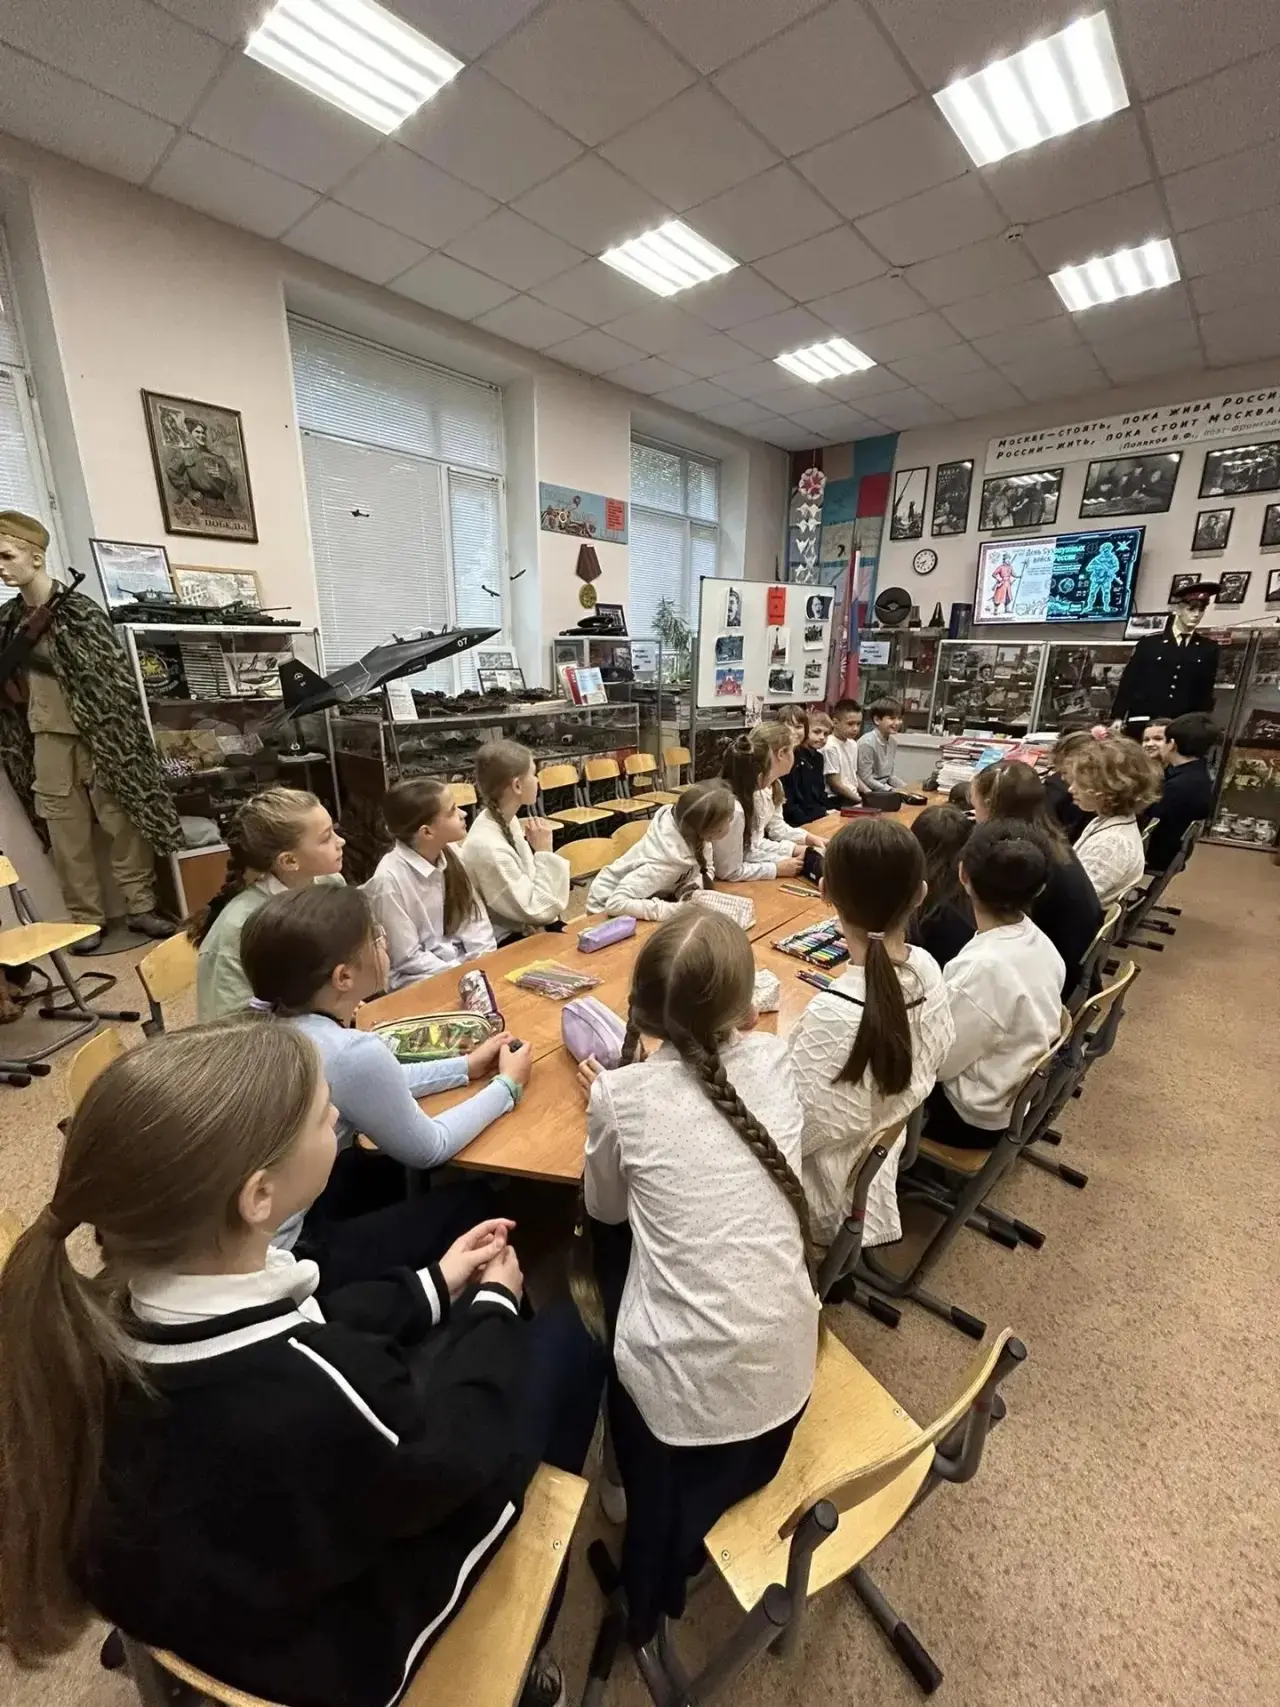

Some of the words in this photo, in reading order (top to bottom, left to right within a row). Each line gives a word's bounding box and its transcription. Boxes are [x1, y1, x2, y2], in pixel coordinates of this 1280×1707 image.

[1122, 411, 1159, 425] ПОКА
[1168, 402, 1212, 417] ЖИВА
[1222, 391, 1280, 408] РОССИ
[1106, 429, 1141, 442] ПОКА
[1151, 418, 1199, 434] СТОИТ
[457, 636, 468, 648] 07
